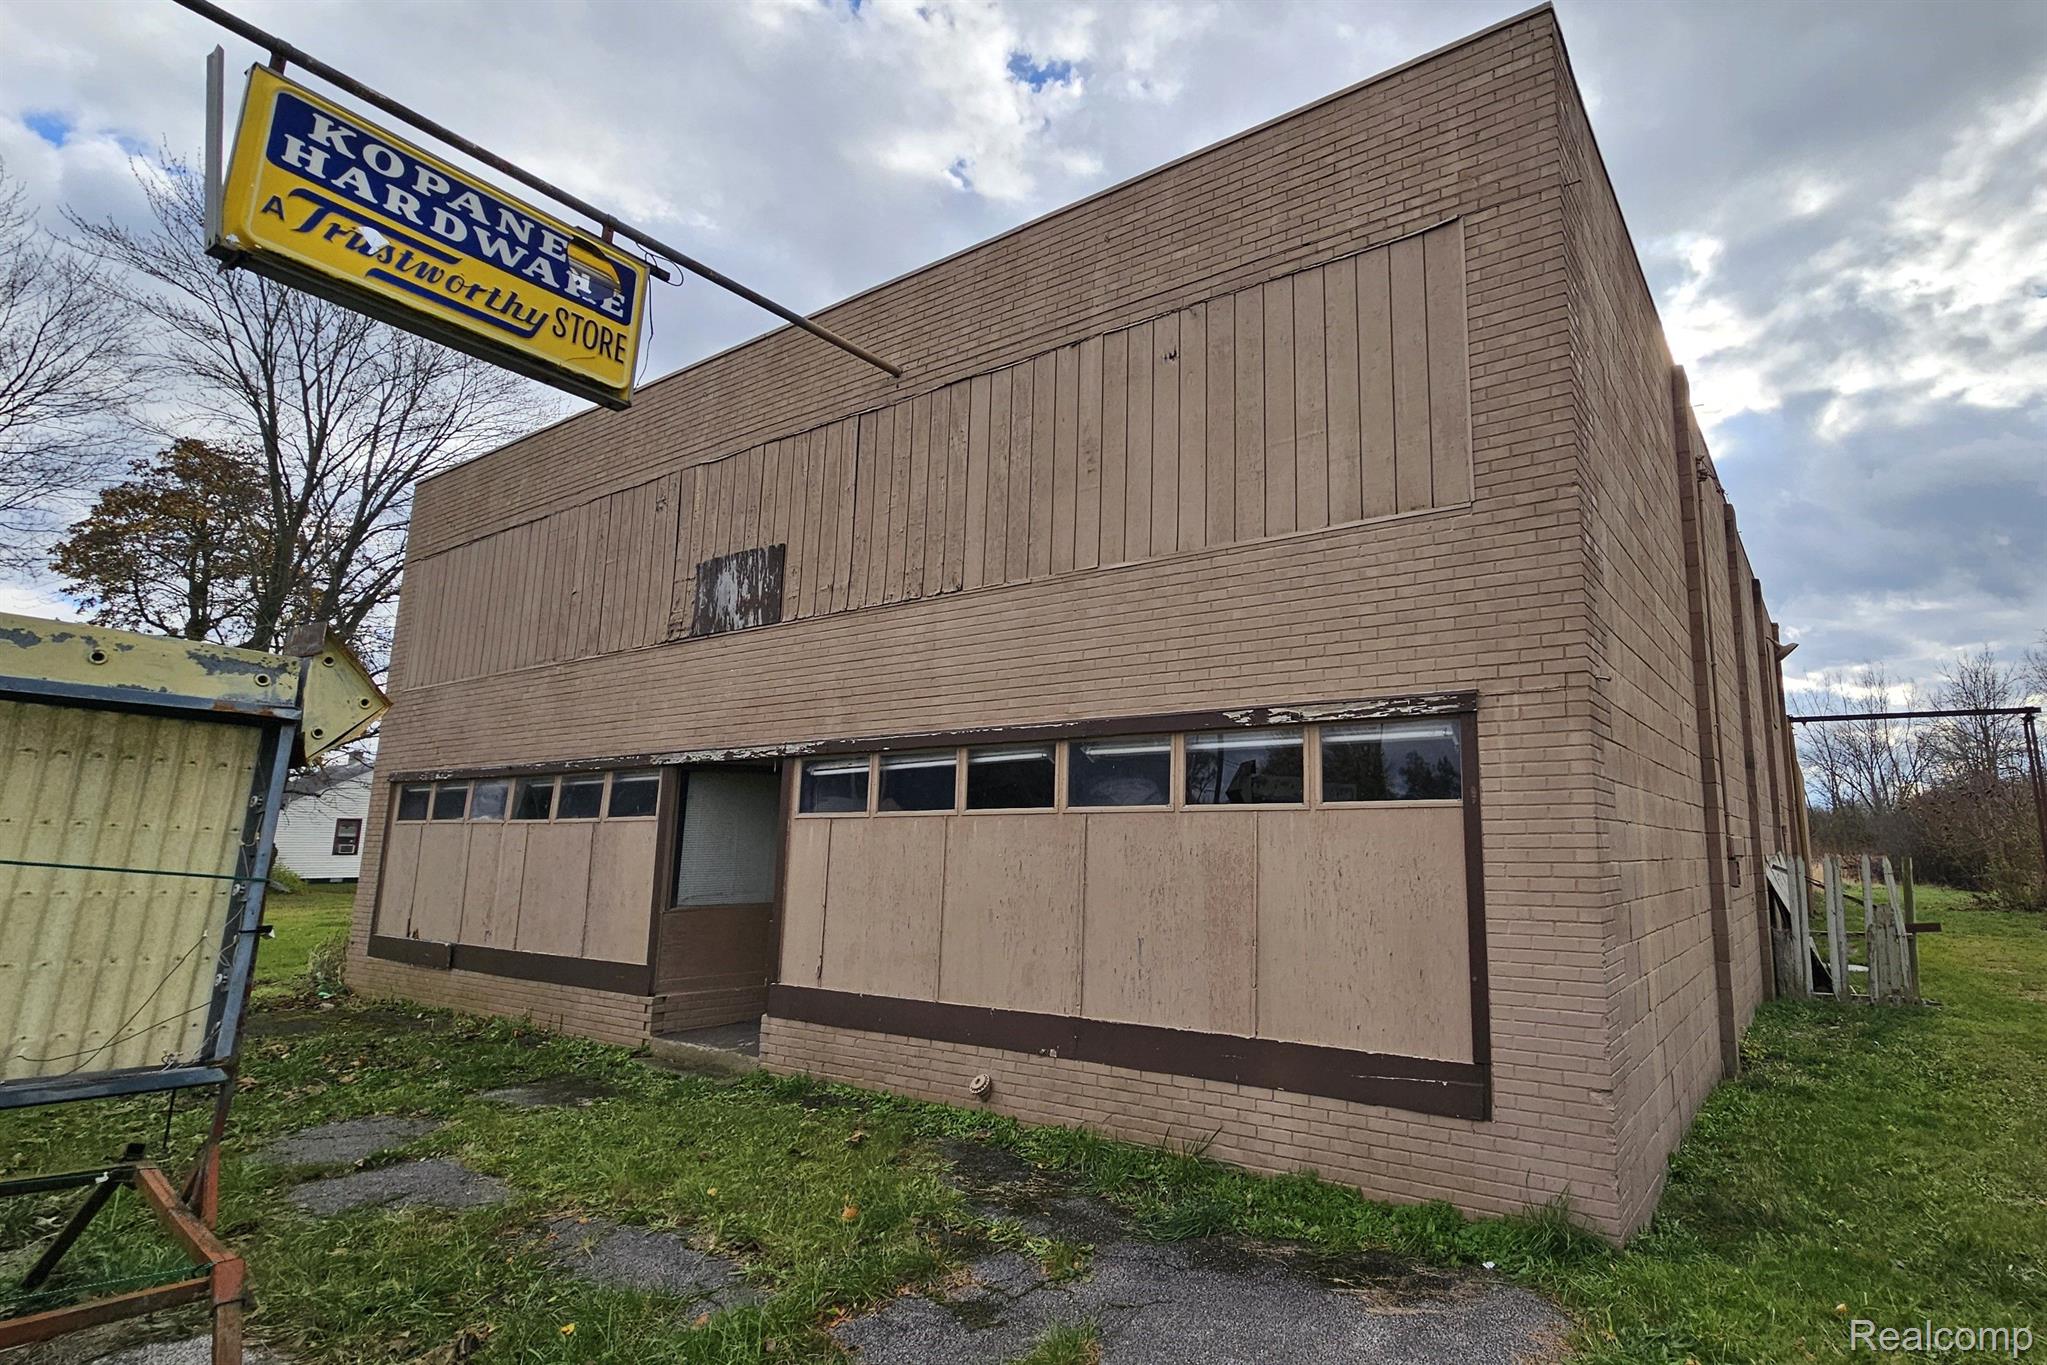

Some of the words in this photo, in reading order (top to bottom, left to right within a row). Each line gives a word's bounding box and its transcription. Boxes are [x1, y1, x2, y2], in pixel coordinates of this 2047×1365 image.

[307, 112, 569, 262] KOPANE
[261, 195, 286, 222] A
[288, 188, 549, 338] Trustworthy
[552, 307, 627, 364] STORE
